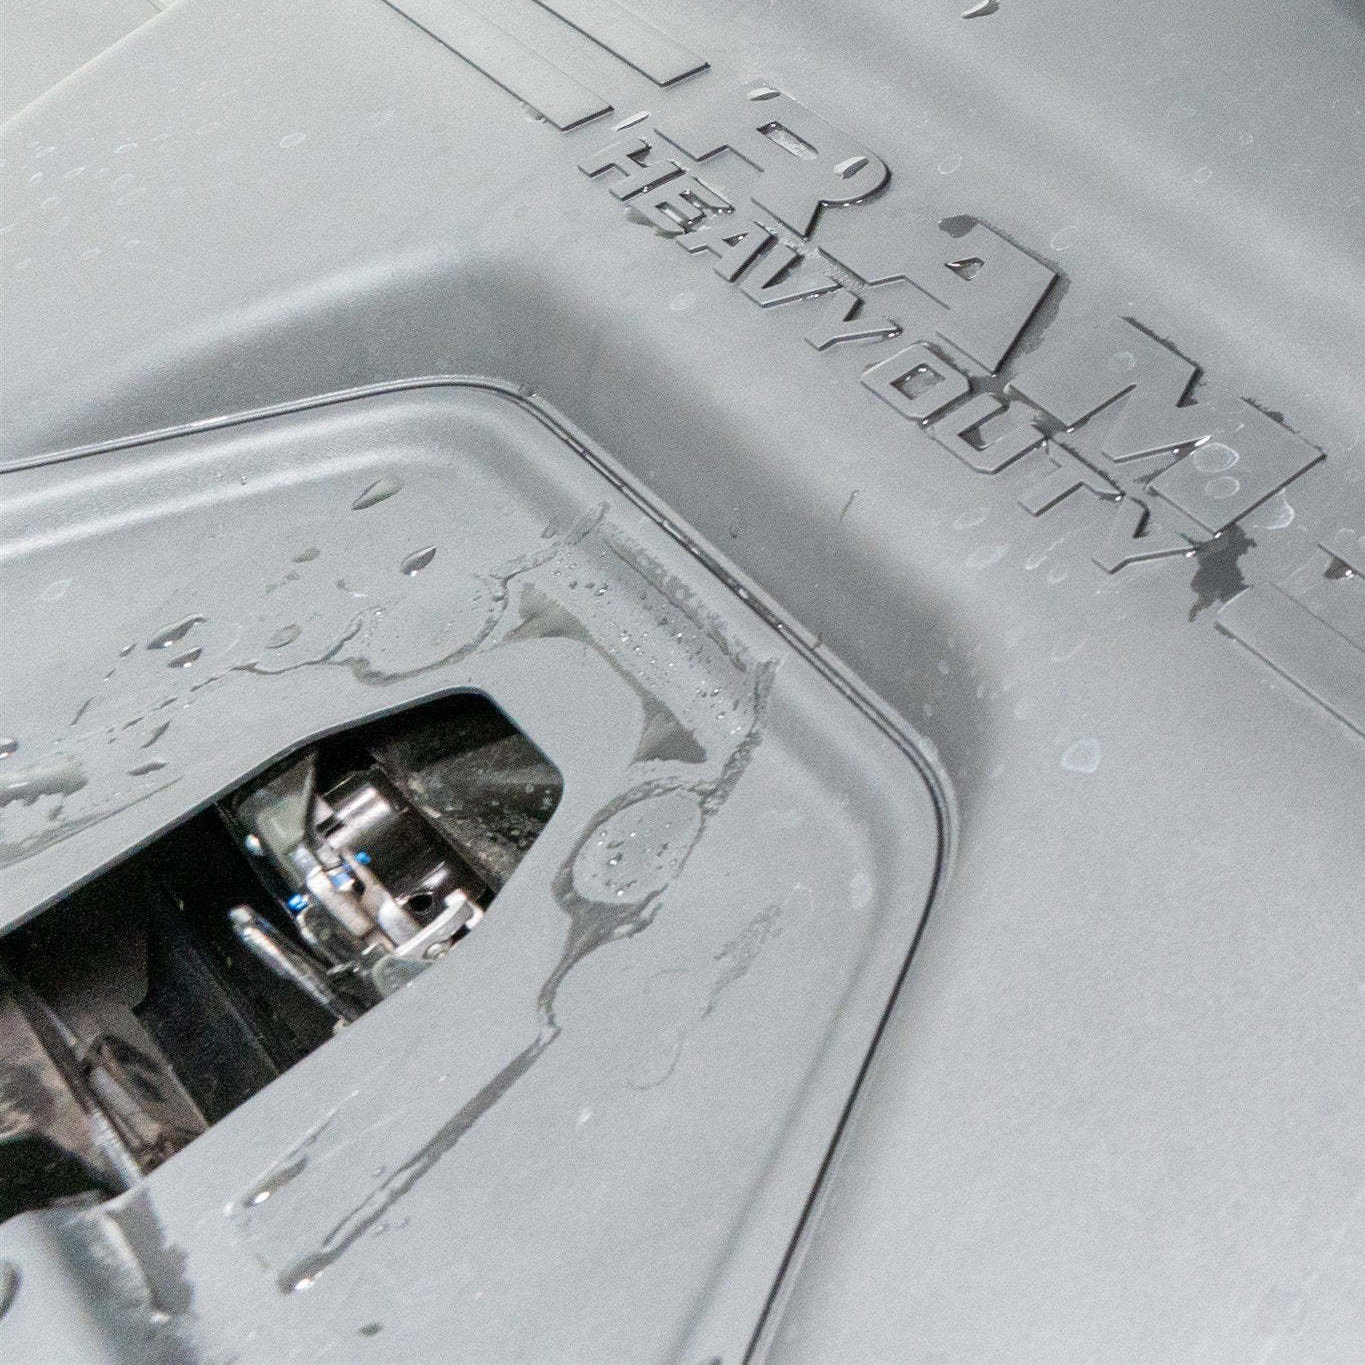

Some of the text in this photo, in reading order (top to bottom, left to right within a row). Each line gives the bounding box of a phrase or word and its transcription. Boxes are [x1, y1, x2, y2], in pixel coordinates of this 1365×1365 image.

[578, 133, 1202, 574] HEAVY DUTY
[656, 79, 1327, 537] RAM
